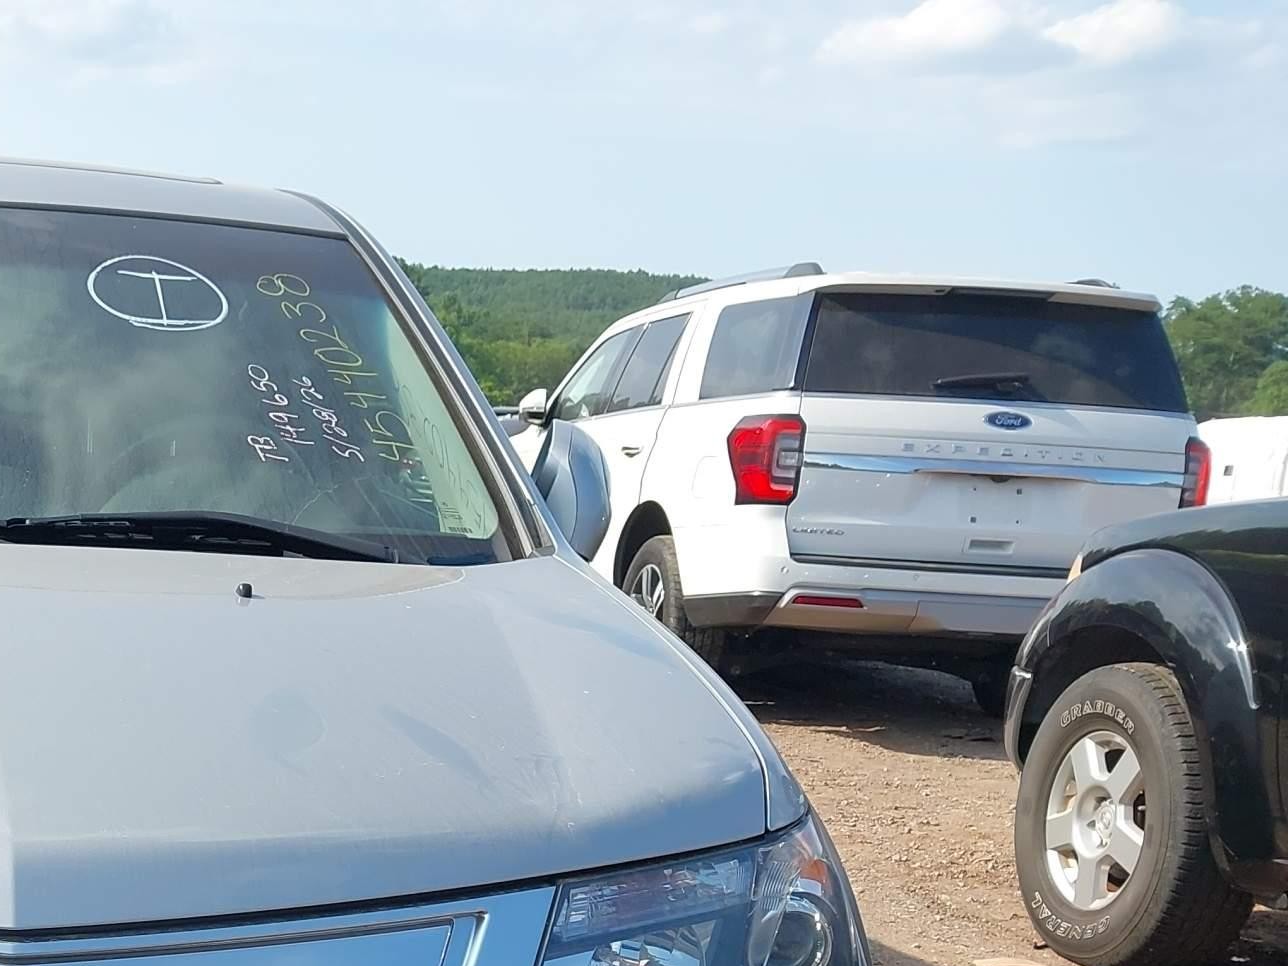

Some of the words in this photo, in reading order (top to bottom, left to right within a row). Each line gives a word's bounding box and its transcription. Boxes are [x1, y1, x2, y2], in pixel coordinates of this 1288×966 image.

[256, 272, 420, 462] 45440238
[901, 441, 1106, 464] EXPEDITION
[1059, 699, 1135, 736] GRABBER
[1031, 891, 1111, 940] GENERAL
